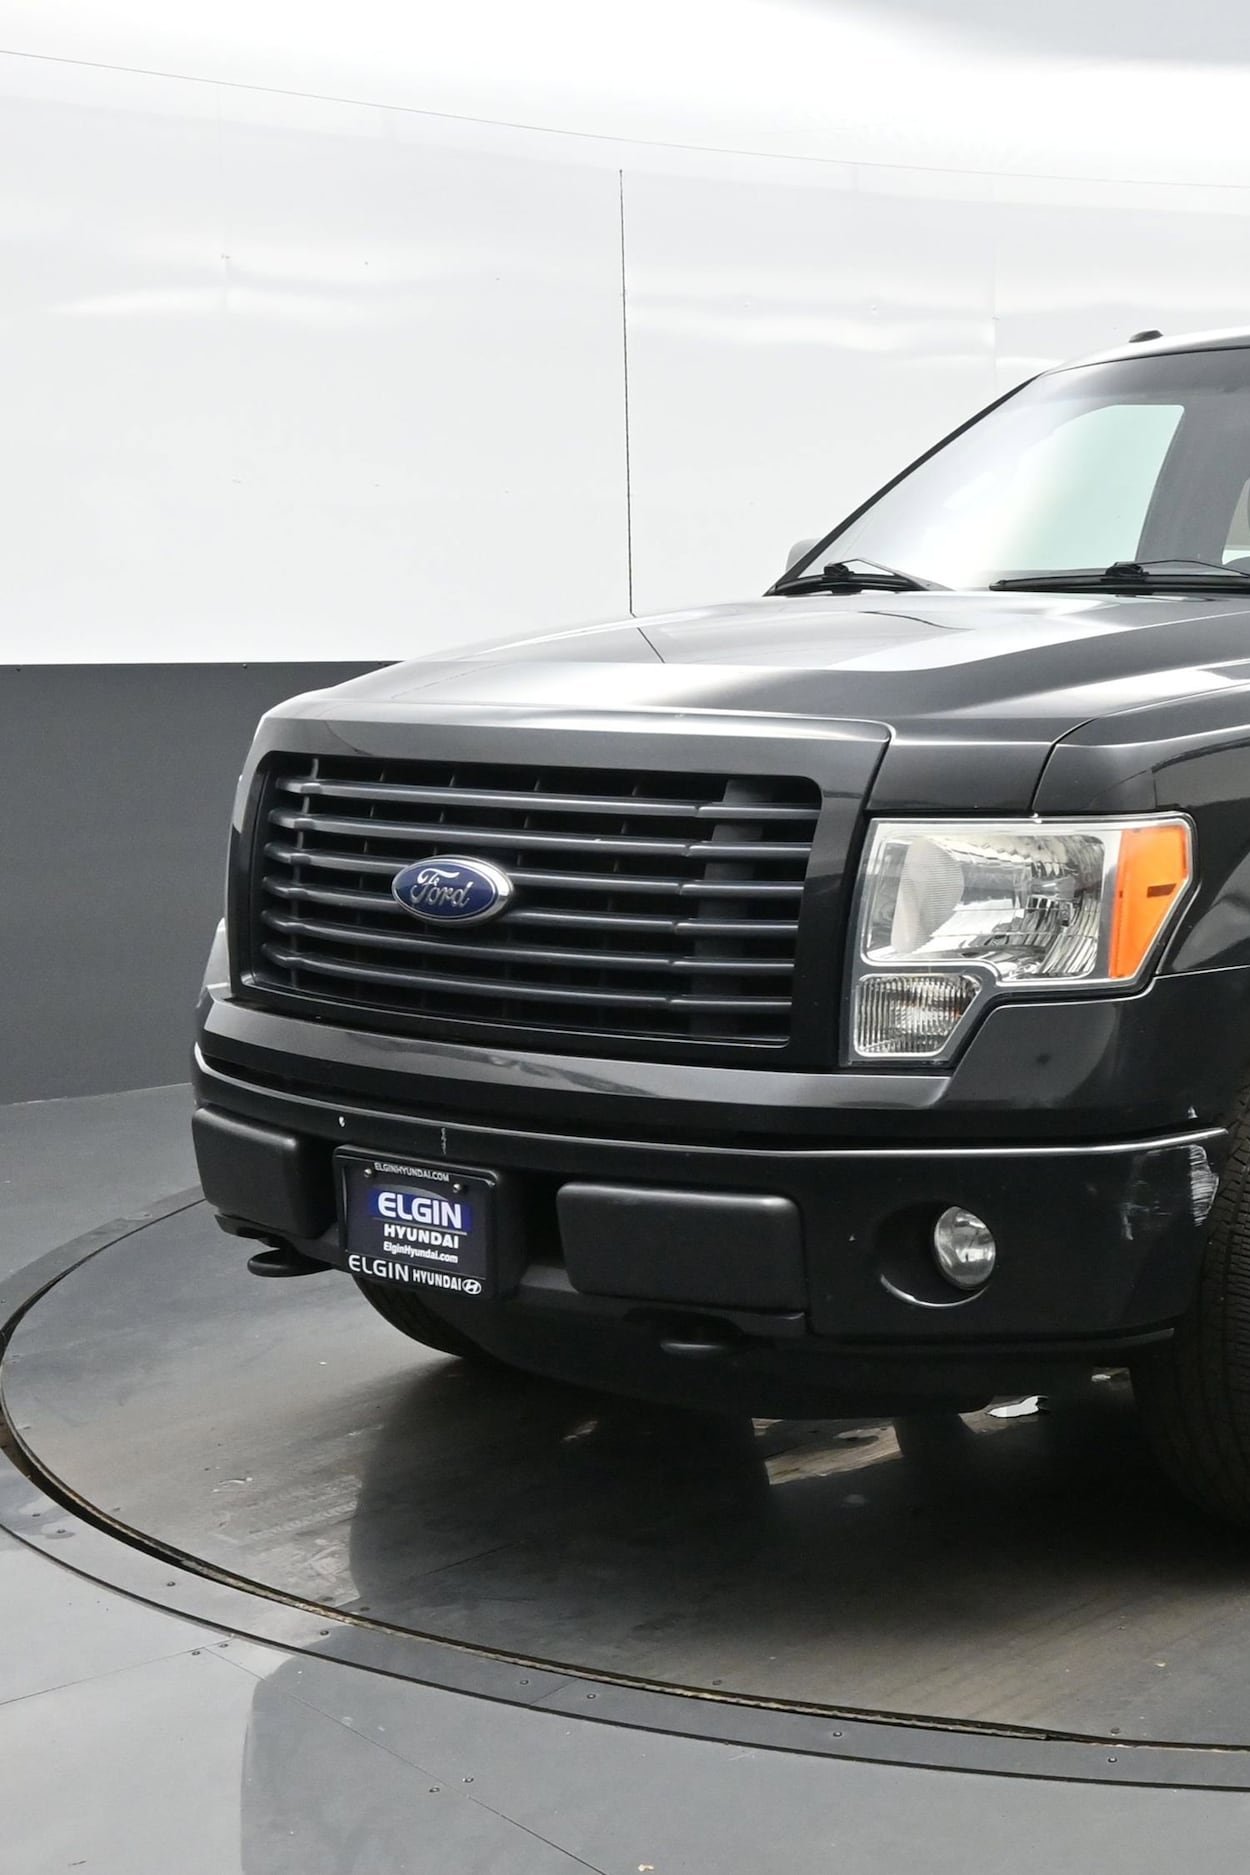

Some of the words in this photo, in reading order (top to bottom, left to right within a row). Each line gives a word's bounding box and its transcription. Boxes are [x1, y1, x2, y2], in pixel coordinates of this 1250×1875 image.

[410, 867, 474, 908] Ford
[373, 1162, 450, 1182] ELGINHYUNDAI.COM
[378, 1191, 462, 1229] ELGIN
[384, 1223, 459, 1249] HYUNDAI
[383, 1241, 458, 1263] ElginHyundai.com
[348, 1254, 410, 1282] ELGIN
[412, 1268, 462, 1291] HYUNDAI
